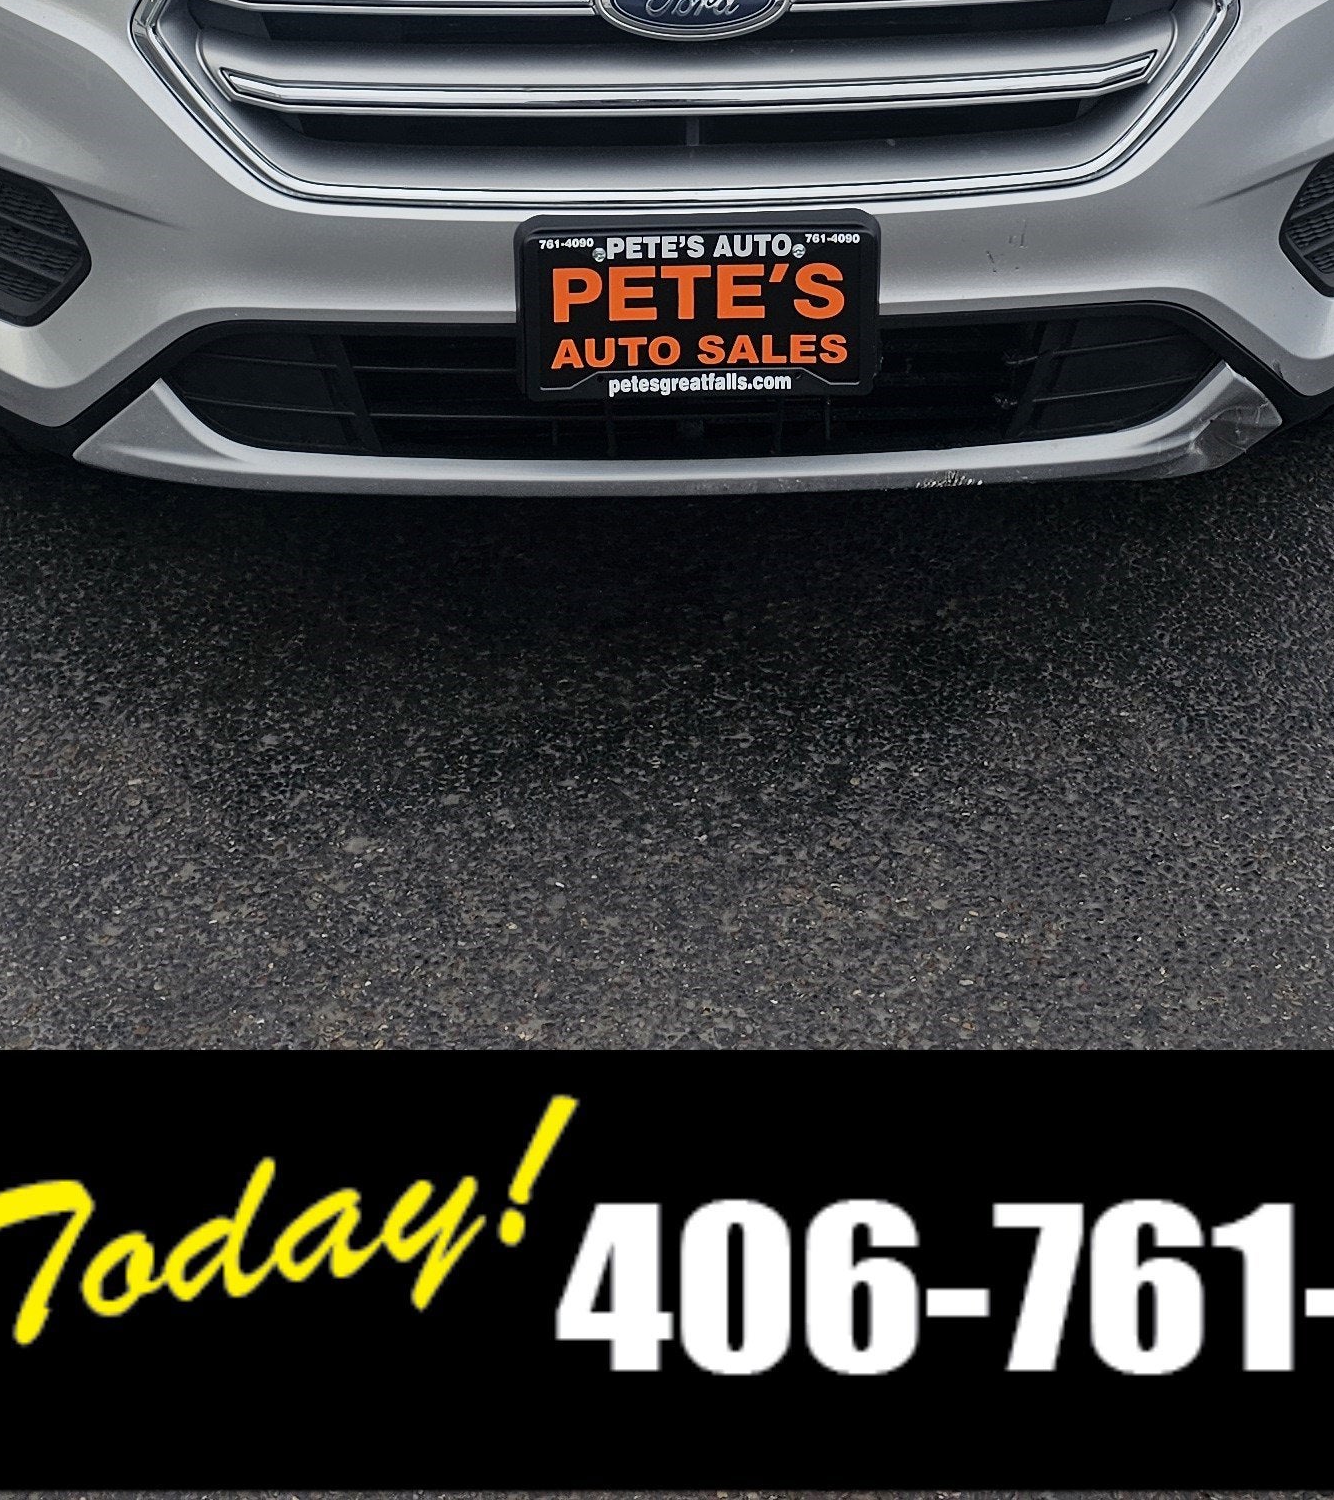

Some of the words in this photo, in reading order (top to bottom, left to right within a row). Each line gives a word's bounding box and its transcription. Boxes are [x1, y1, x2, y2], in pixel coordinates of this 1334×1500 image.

[539, 238, 594, 250] 761-4090
[606, 234, 705, 260] PETE'S
[713, 233, 792, 258] AUTO
[804, 233, 860, 244] 761-4090
[552, 262, 845, 323] PETE'S
[551, 335, 681, 369] AUTO
[697, 334, 848, 365] SALES
[608, 371, 792, 397] petesgreatfalls.com
